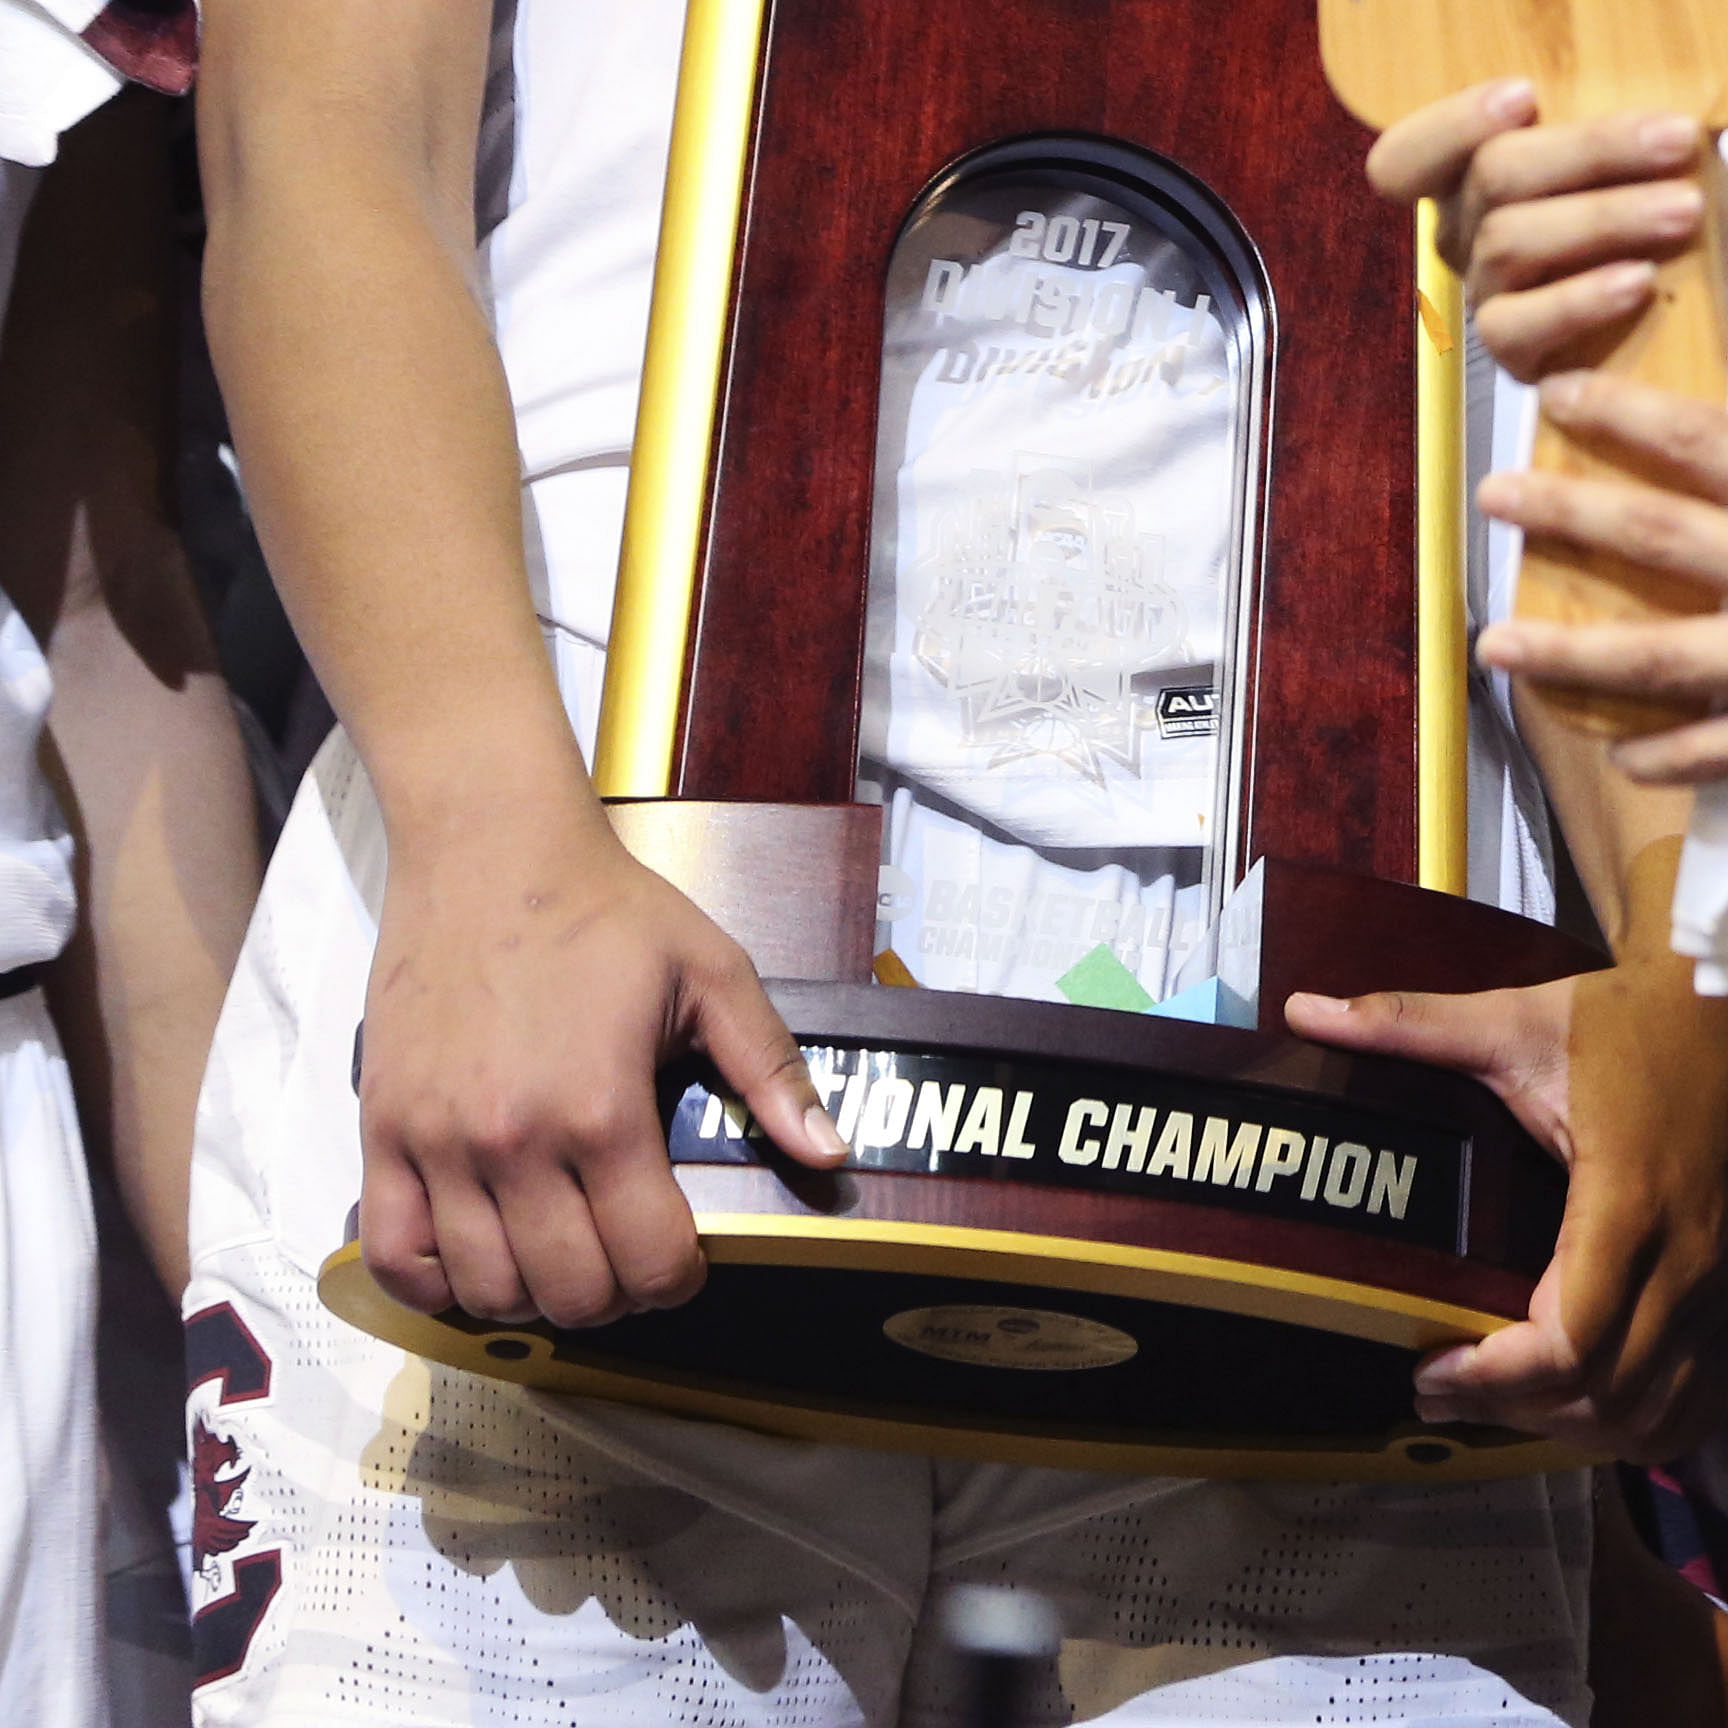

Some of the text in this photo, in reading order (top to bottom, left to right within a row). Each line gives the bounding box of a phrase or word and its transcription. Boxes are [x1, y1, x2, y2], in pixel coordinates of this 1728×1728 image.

[1008, 210, 1131, 269] 2017
[920, 257, 1178, 342] DIVISION
[925, 878, 1190, 951] BASKETBALL
[698, 1072, 1419, 1221] NTIONAL CHAMPION
